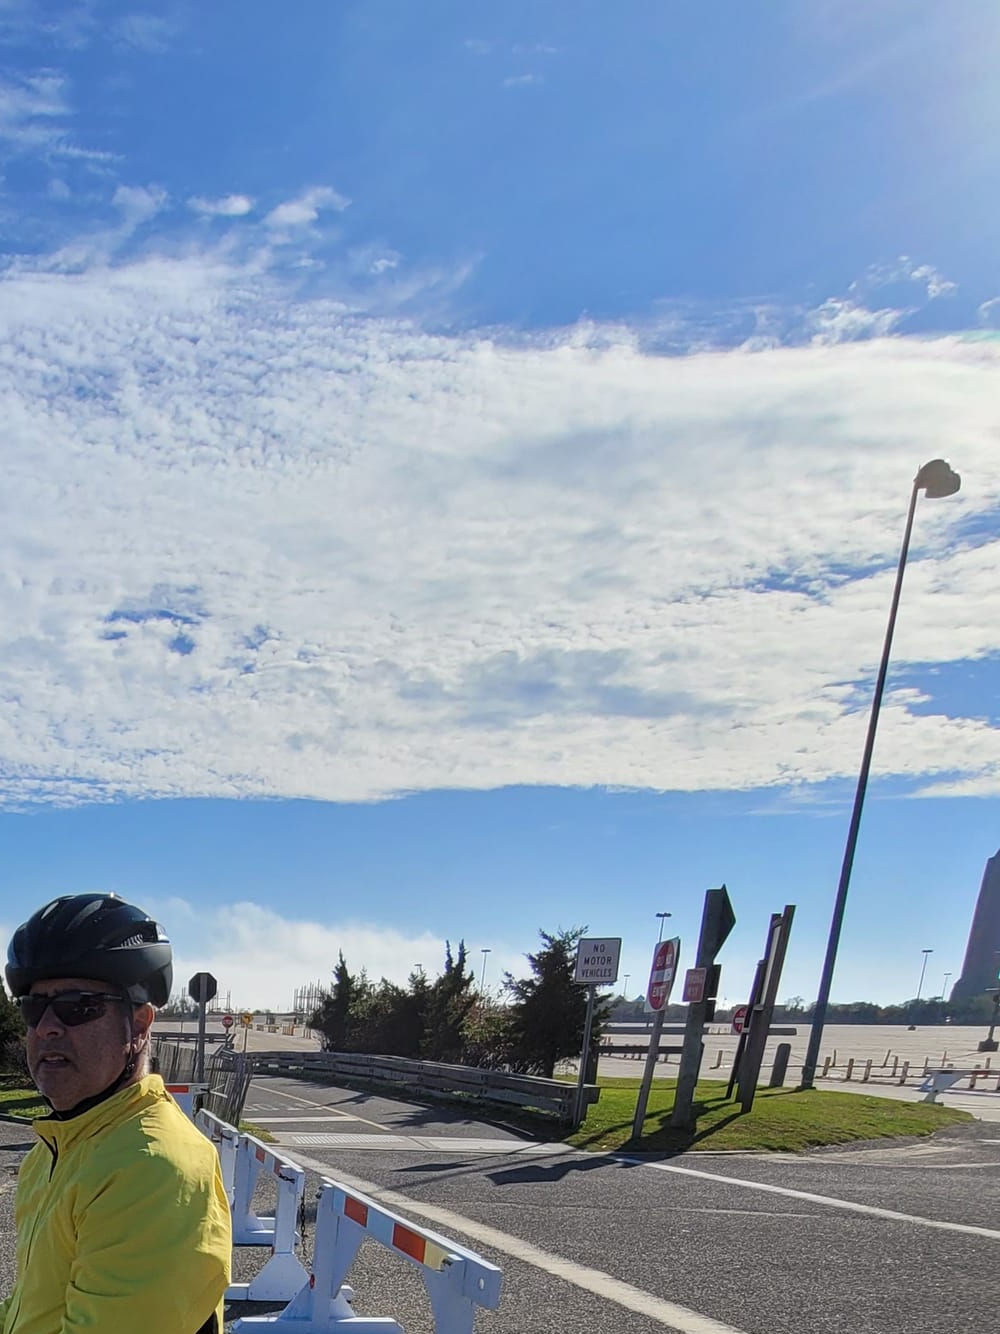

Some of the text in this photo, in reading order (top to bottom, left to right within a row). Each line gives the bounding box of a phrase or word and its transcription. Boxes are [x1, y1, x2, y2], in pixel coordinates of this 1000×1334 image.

[593, 943, 605, 953] NO
[584, 956, 613, 965] MOTOR
[581, 968, 613, 978] VEHICLES
